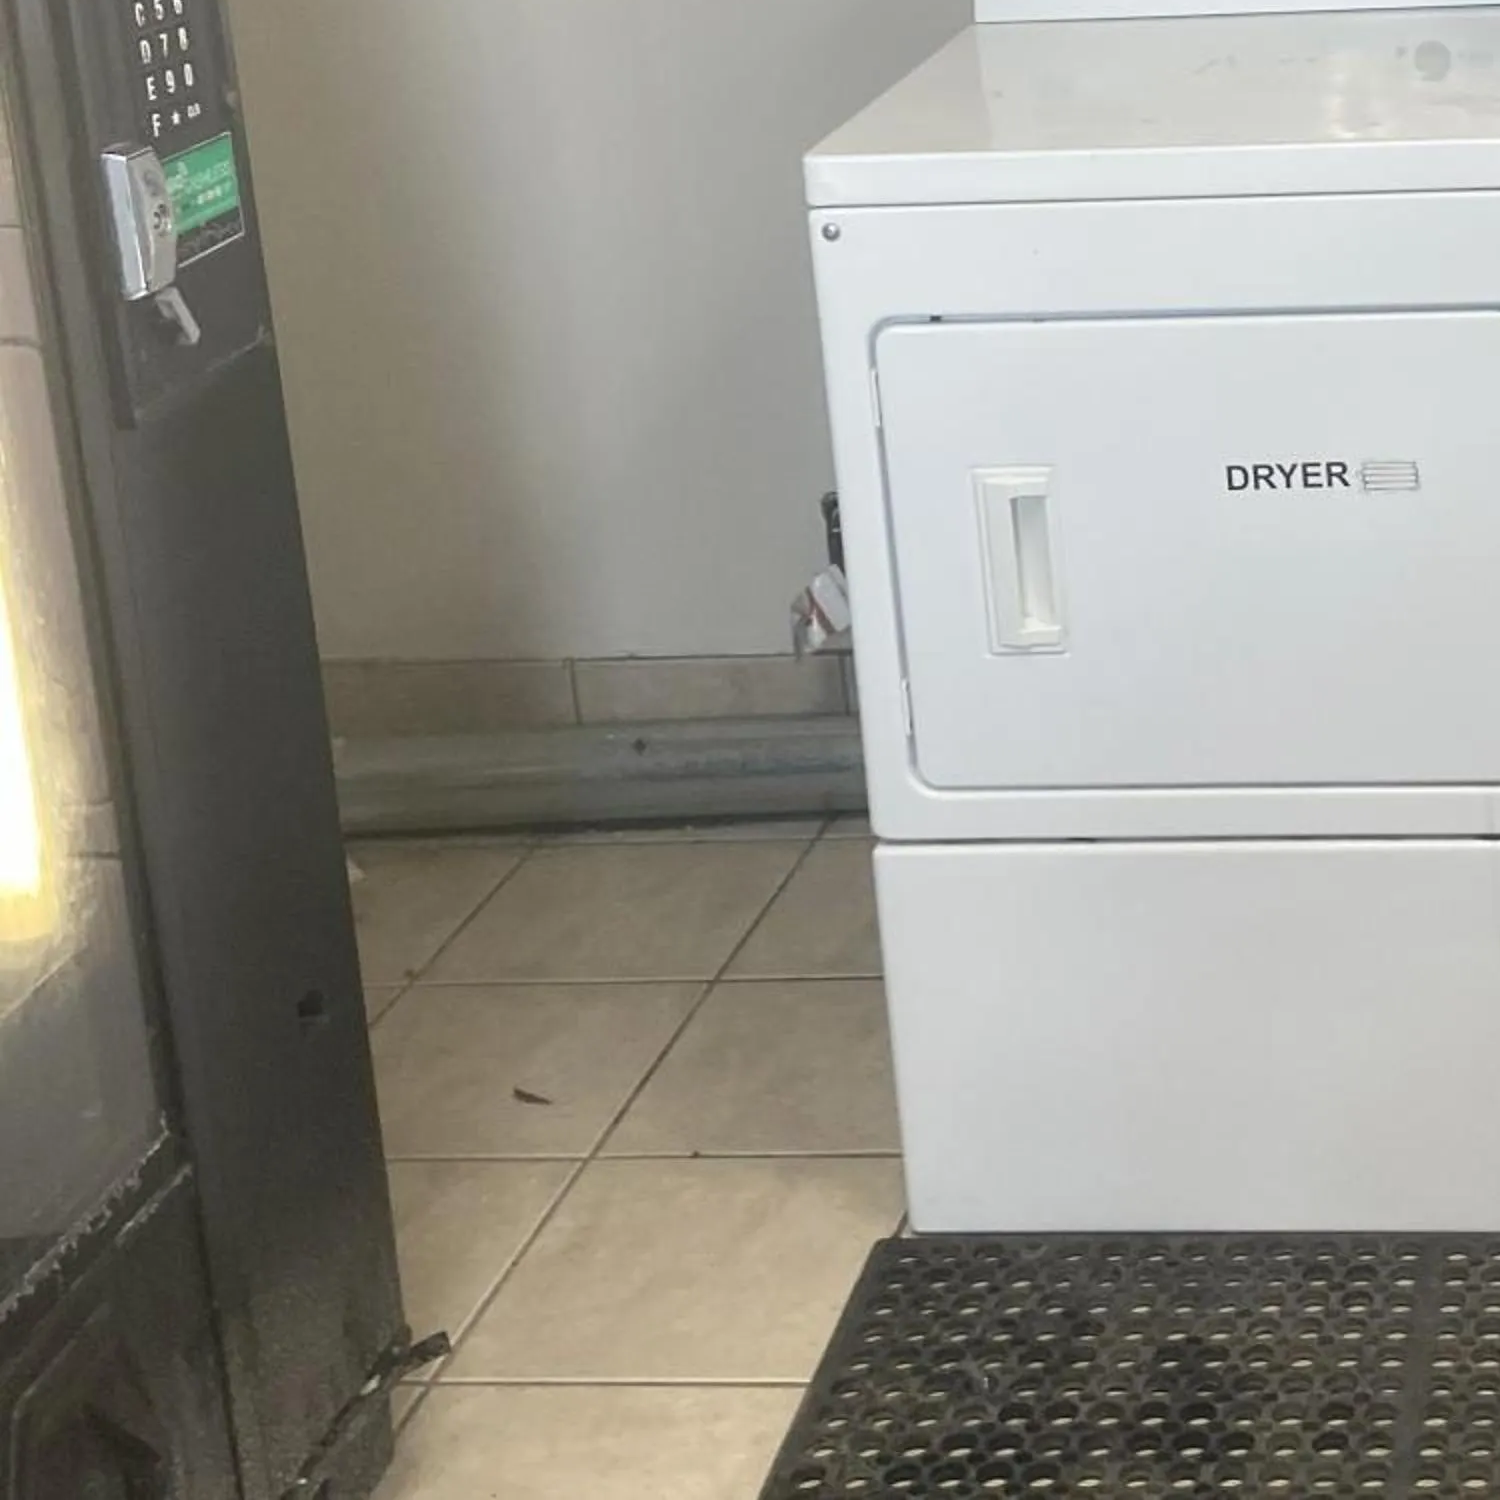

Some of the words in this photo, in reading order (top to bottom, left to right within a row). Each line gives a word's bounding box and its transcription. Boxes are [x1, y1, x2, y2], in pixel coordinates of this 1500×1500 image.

[134, 1, 146, 28] C
[159, 33, 168, 58] 7
[177, 27, 189, 51] 8
[146, 75, 157, 101] E
[165, 69, 176, 94] 9
[151, 113, 161, 138] F
[1225, 461, 1351, 491] DRYER
